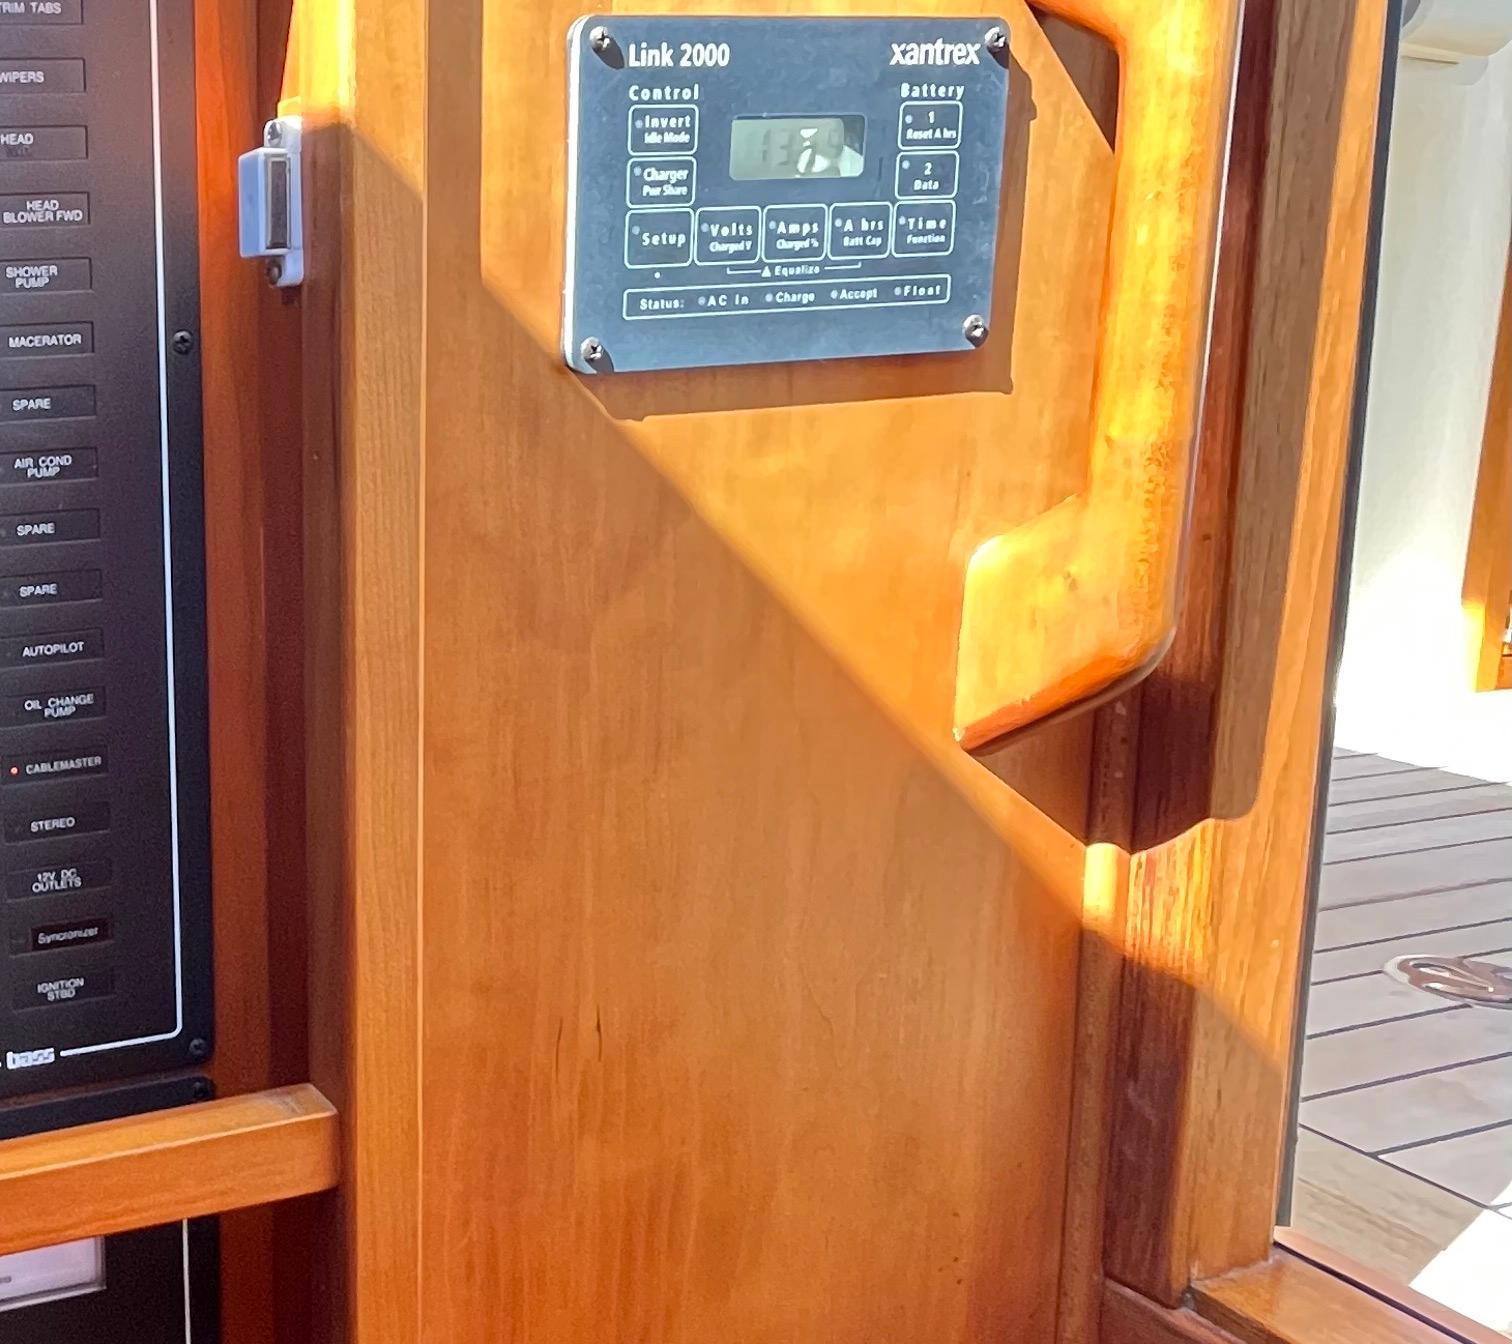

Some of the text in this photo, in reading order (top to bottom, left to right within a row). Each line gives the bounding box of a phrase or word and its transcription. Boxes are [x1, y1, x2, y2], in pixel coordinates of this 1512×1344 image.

[30, 1, 62, 14] TABS
[628, 41, 731, 67] Link 2000
[889, 37, 981, 66] xantrex
[628, 83, 699, 101] Control
[900, 82, 965, 101] Battery
[644, 114, 691, 128] Invert
[928, 111, 935, 124] 1
[0, 133, 34, 146] HEAD
[644, 131, 691, 144] Idle Mode
[906, 128, 933, 140] Reset
[643, 167, 689, 184] Charger
[924, 162, 933, 176] 2
[662, 184, 688, 196] Share
[913, 179, 939, 191] Data
[26, 200, 59, 211] HEAD
[3, 209, 83, 223] BLOWER FWD
[710, 222, 753, 237] Volts
[776, 221, 819, 236] Amps
[844, 218, 884, 232] A hrs
[907, 217, 947, 230] Time
[642, 232, 686, 248] Setup
[865, 235, 882, 247] Cap
[906, 234, 946, 244] Function
[6, 265, 57, 278] SHOWER
[775, 265, 820, 277] Equalize
[15, 277, 50, 289] PUMP
[640, 285, 941, 311] Status: AC In Charge Accept Float
[8, 333, 82, 348] MACERATOR
[12, 398, 51, 411] SPARE
[14, 454, 73, 470] AIR COND
[27, 467, 60, 478] PUMP
[16, 522, 55, 536] SPARE
[19, 583, 58, 597] SPARE
[22, 641, 85, 658] AUTOPILOT
[24, 693, 94, 711] OIL CHANGE
[44, 706, 76, 718] PUMP
[26, 756, 102, 774] CABLEMASTER
[30, 817, 76, 832] STEREO
[61, 868, 77, 879] DC
[32, 877, 82, 893] OUTLETS
[37, 977, 85, 994] IGNITION
[47, 989, 76, 1001] STBD
